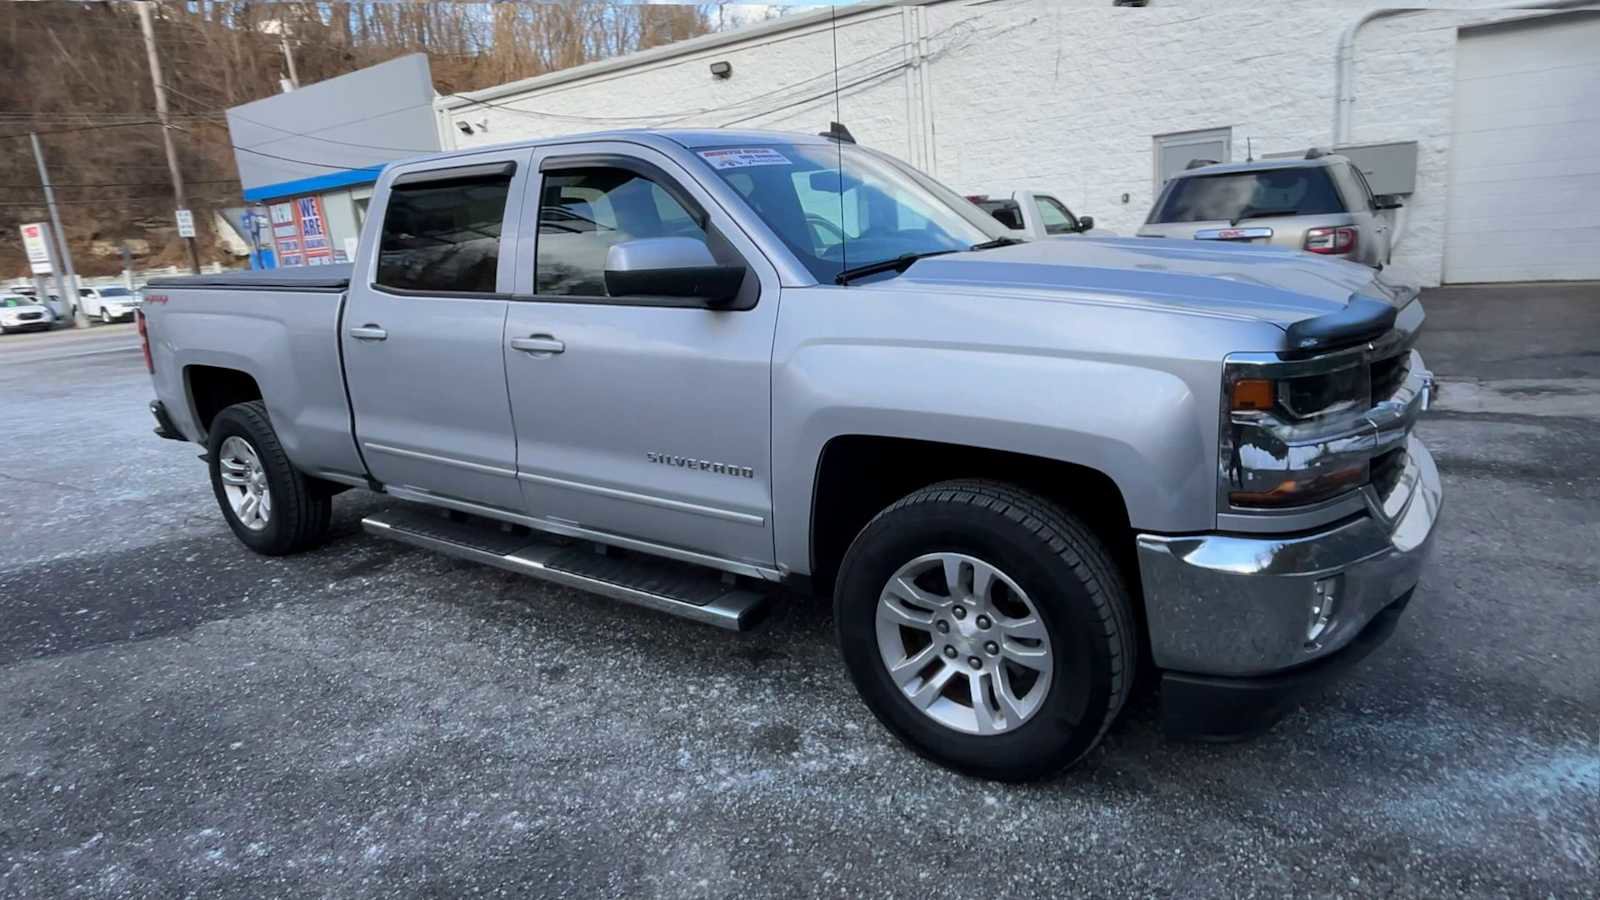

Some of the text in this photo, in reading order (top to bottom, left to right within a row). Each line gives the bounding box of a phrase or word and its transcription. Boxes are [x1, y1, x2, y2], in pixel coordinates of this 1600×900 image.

[299, 198, 318, 217] WE
[303, 217, 323, 236] ARE
[647, 451, 754, 479] SILVERADO
